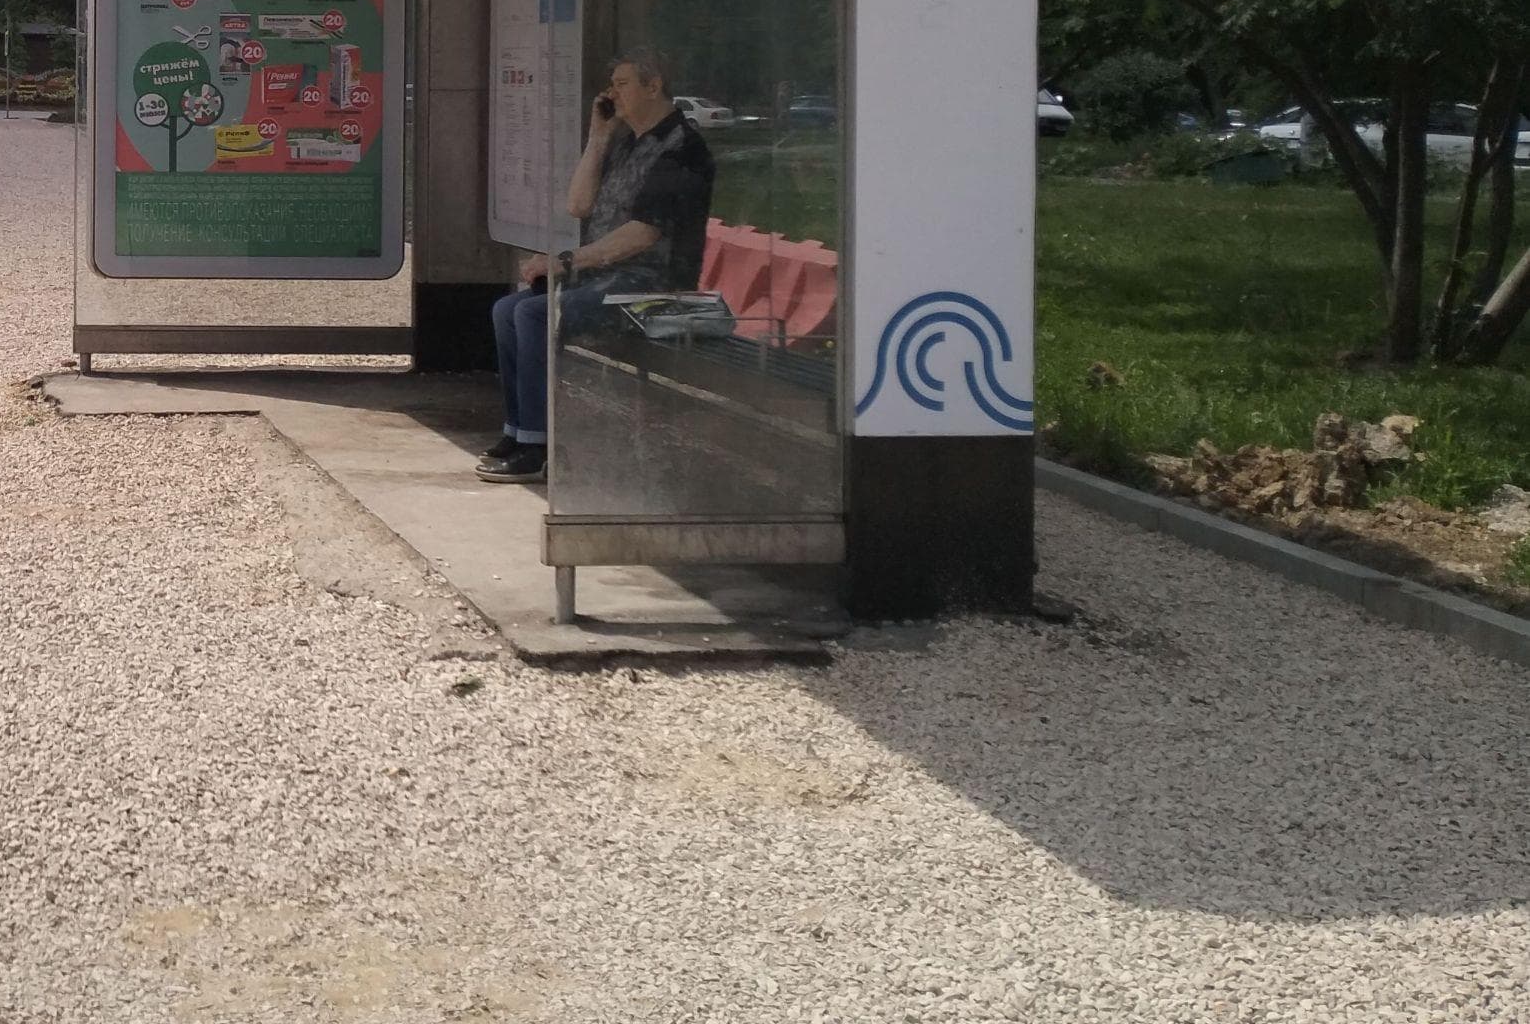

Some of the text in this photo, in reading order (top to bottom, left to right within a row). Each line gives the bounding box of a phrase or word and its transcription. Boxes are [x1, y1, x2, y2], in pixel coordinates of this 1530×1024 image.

[324, 16, 342, 26] 20
[244, 47, 262, 58] 20
[140, 57, 200, 75] стрижём
[303, 91, 320, 102] 20
[352, 92, 369, 103] 20
[259, 123, 277, 134] 20
[341, 124, 359, 135] 20
